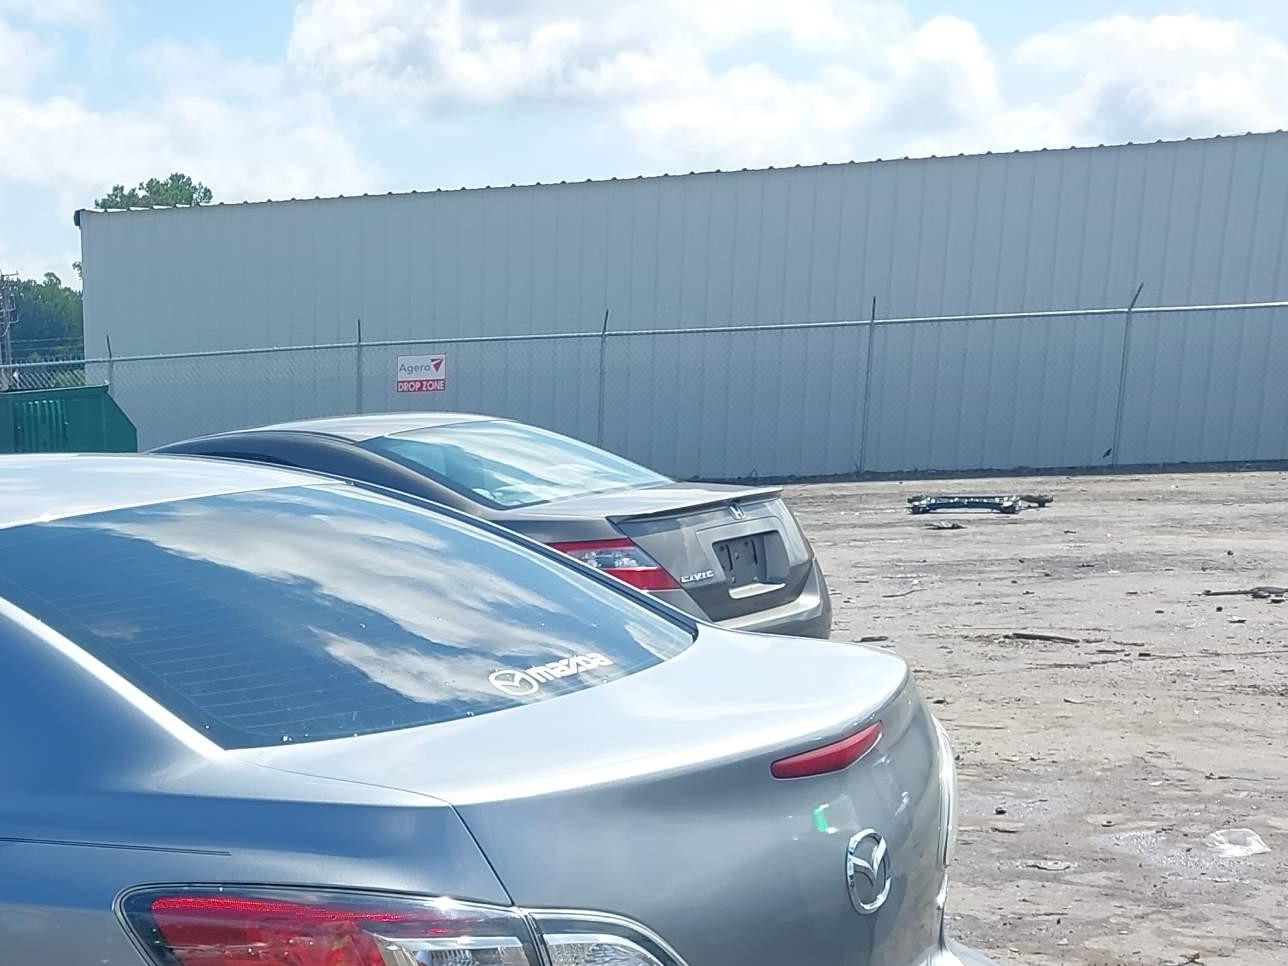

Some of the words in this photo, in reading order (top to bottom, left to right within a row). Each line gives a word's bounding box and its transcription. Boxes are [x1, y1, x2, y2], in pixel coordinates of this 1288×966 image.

[399, 363, 431, 374] Agero
[398, 381, 421, 392] DROP
[421, 380, 444, 391] ZONE
[680, 570, 715, 583] CIVIC
